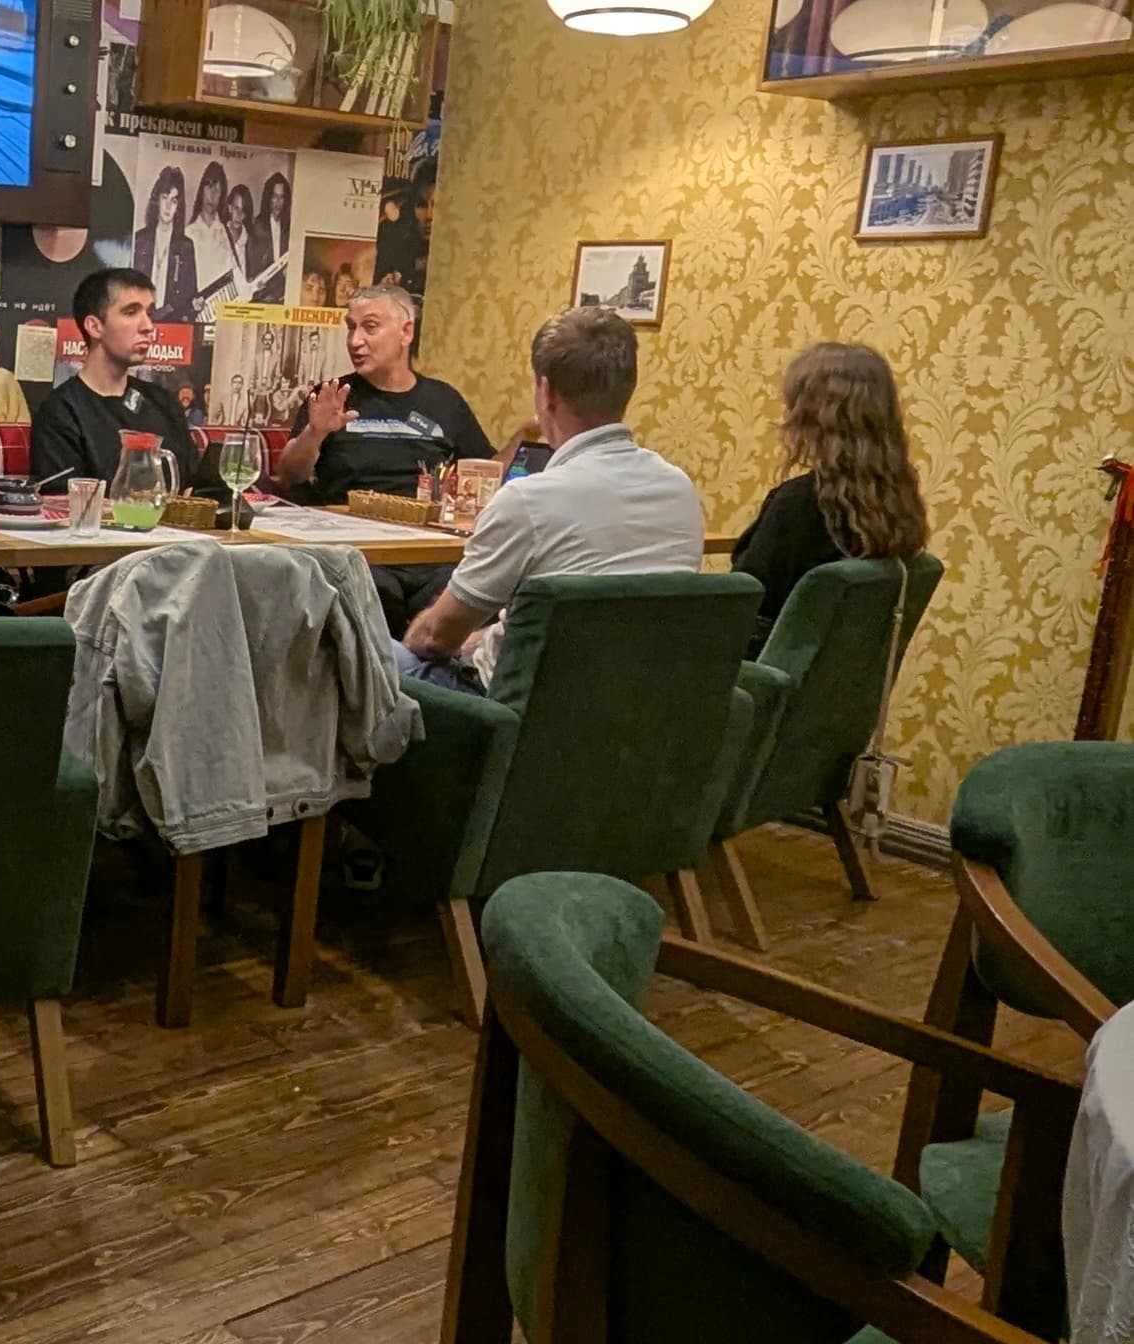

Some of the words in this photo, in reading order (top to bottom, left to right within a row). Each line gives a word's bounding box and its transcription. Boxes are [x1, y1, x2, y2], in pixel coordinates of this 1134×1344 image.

[119, 112, 202, 137] прекрасен
[207, 124, 238, 142] мир
[292, 307, 343, 324] ПЕСНЯРЫ
[146, 344, 184, 360] ЛОДЫХ
